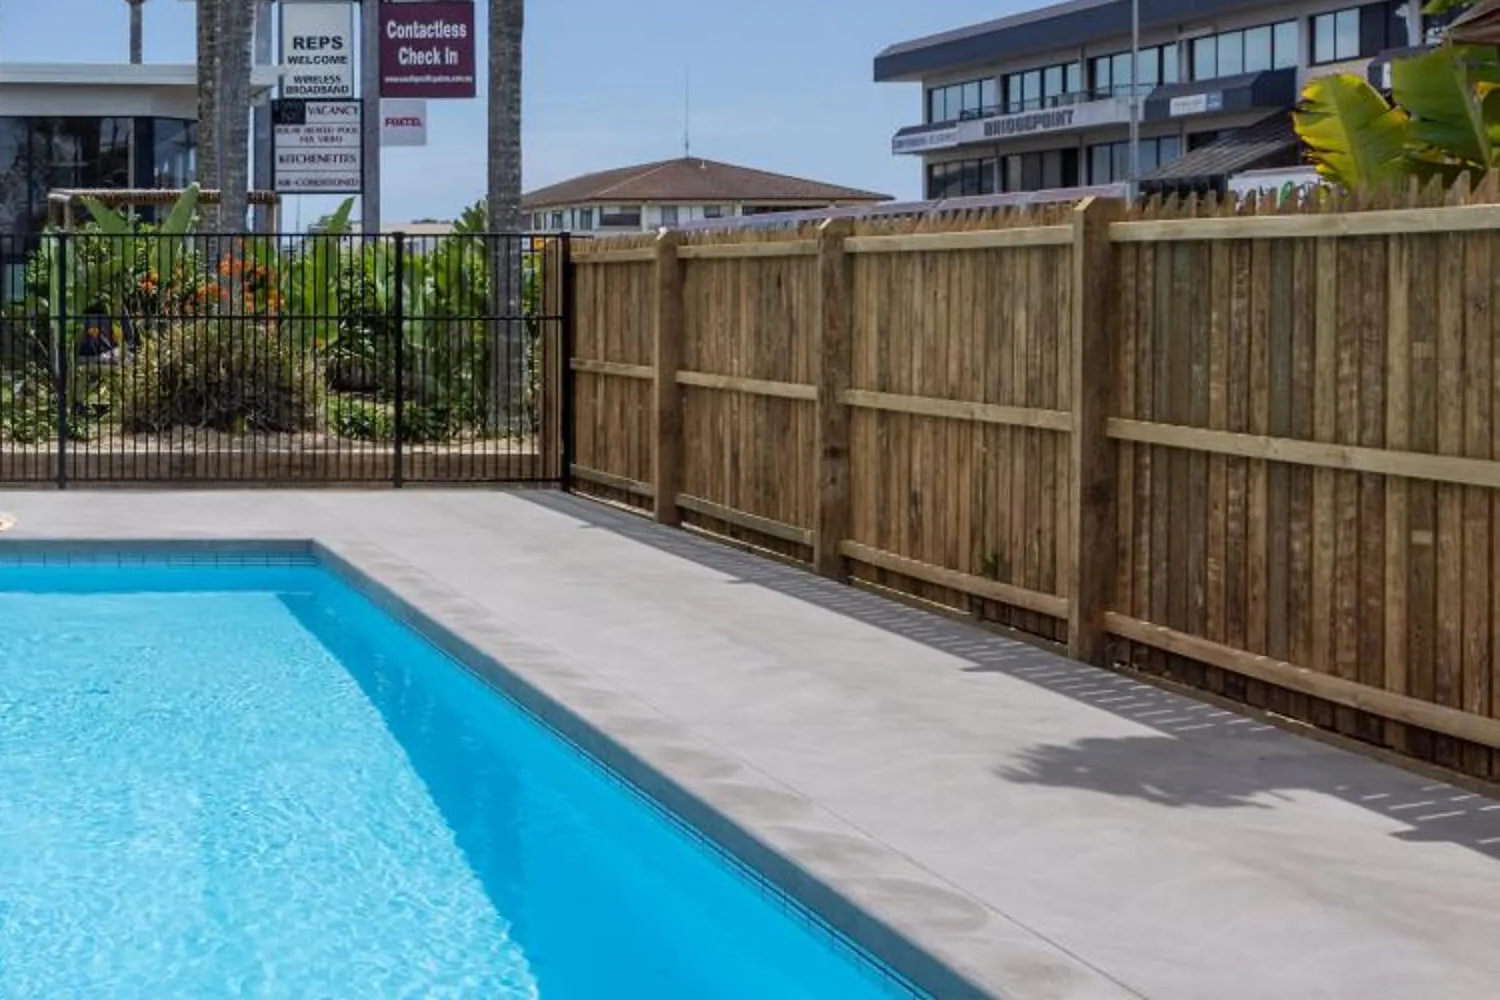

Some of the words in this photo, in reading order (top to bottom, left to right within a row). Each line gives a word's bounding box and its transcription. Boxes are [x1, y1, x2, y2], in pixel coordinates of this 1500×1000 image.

[386, 19, 467, 39] Contactless
[292, 35, 343, 50] REPS
[287, 55, 349, 65] WELCOME
[399, 46, 441, 65] Check
[445, 47, 459, 65] In
[293, 75, 341, 84] WIRELESS
[285, 85, 349, 94] BROADBAND
[307, 105, 358, 116] VACANCY
[278, 153, 357, 165] KITCHENETTES
